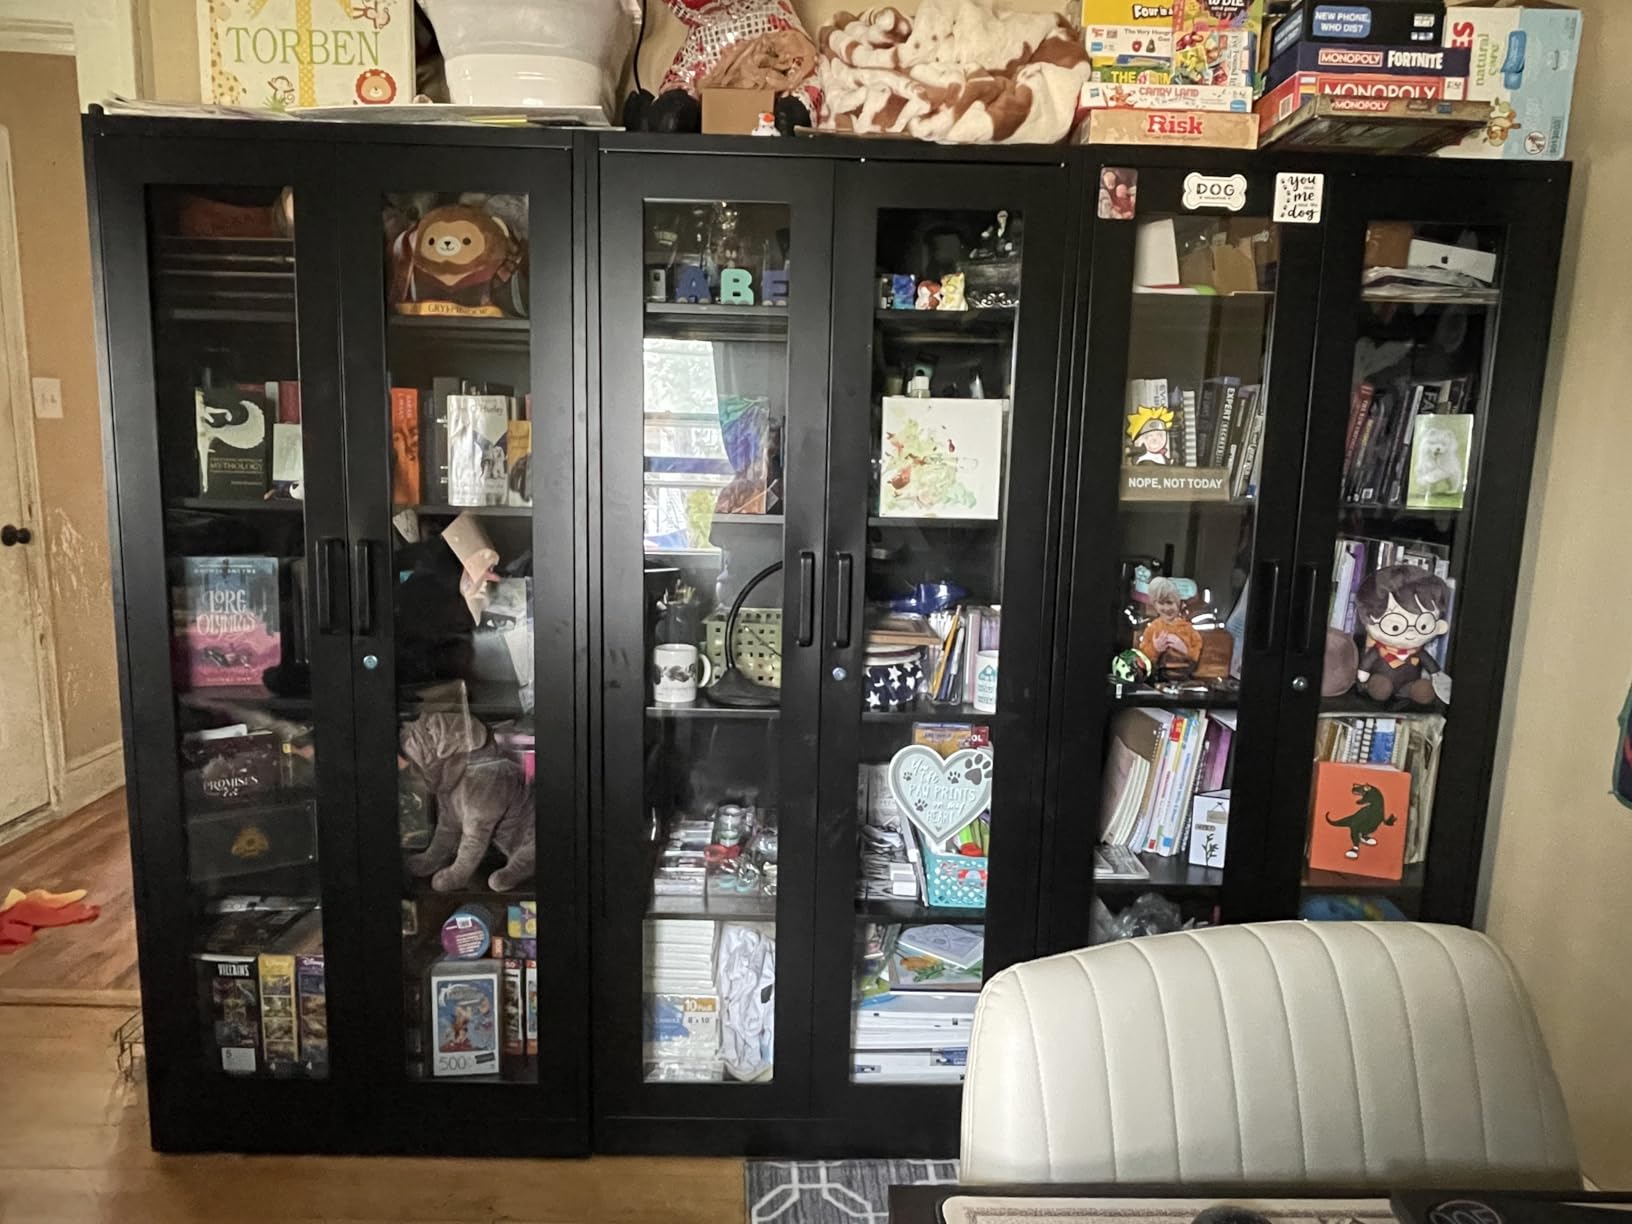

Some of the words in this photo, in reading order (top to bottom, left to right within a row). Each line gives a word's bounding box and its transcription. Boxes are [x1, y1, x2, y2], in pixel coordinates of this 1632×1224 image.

[1315, 11, 1338, 22] NEW
[1320, 22, 1341, 32] WHO
[1343, 23, 1364, 33] DIS?
[225, 26, 381, 66] TORBEN
[1321, 54, 1381, 65] MONOPOLY
[1387, 50, 1444, 69] FORTNITE
[1475, 33, 1490, 87] natural
[1487, 43, 1500, 77] care
[1111, 71, 1137, 84] THE
[1138, 87, 1173, 97] CANDY
[1174, 88, 1199, 97] LAND
[1323, 83, 1437, 100] MONOPOLY
[1334, 101, 1389, 111] MONOPOLY
[1147, 114, 1203, 135] Risk
[1196, 183, 1235, 197] DOG
[1287, 175, 1316, 192] you
[1293, 191, 1315, 202] me
[1287, 204, 1319, 222] dog
[1222, 387, 1236, 421] EXPERT
[1128, 477, 1161, 489] NOPE,
[1163, 478, 1186, 489] NOT
[1187, 478, 1223, 489] TODAY
[209, 589, 247, 614] LORE
[910, 784, 931, 799] PAW
[935, 785, 977, 801] PRINTS
[217, 963, 250, 977] VILLAINS
[684, 999, 697, 1012] 10
[439, 1055, 466, 1071] 500
